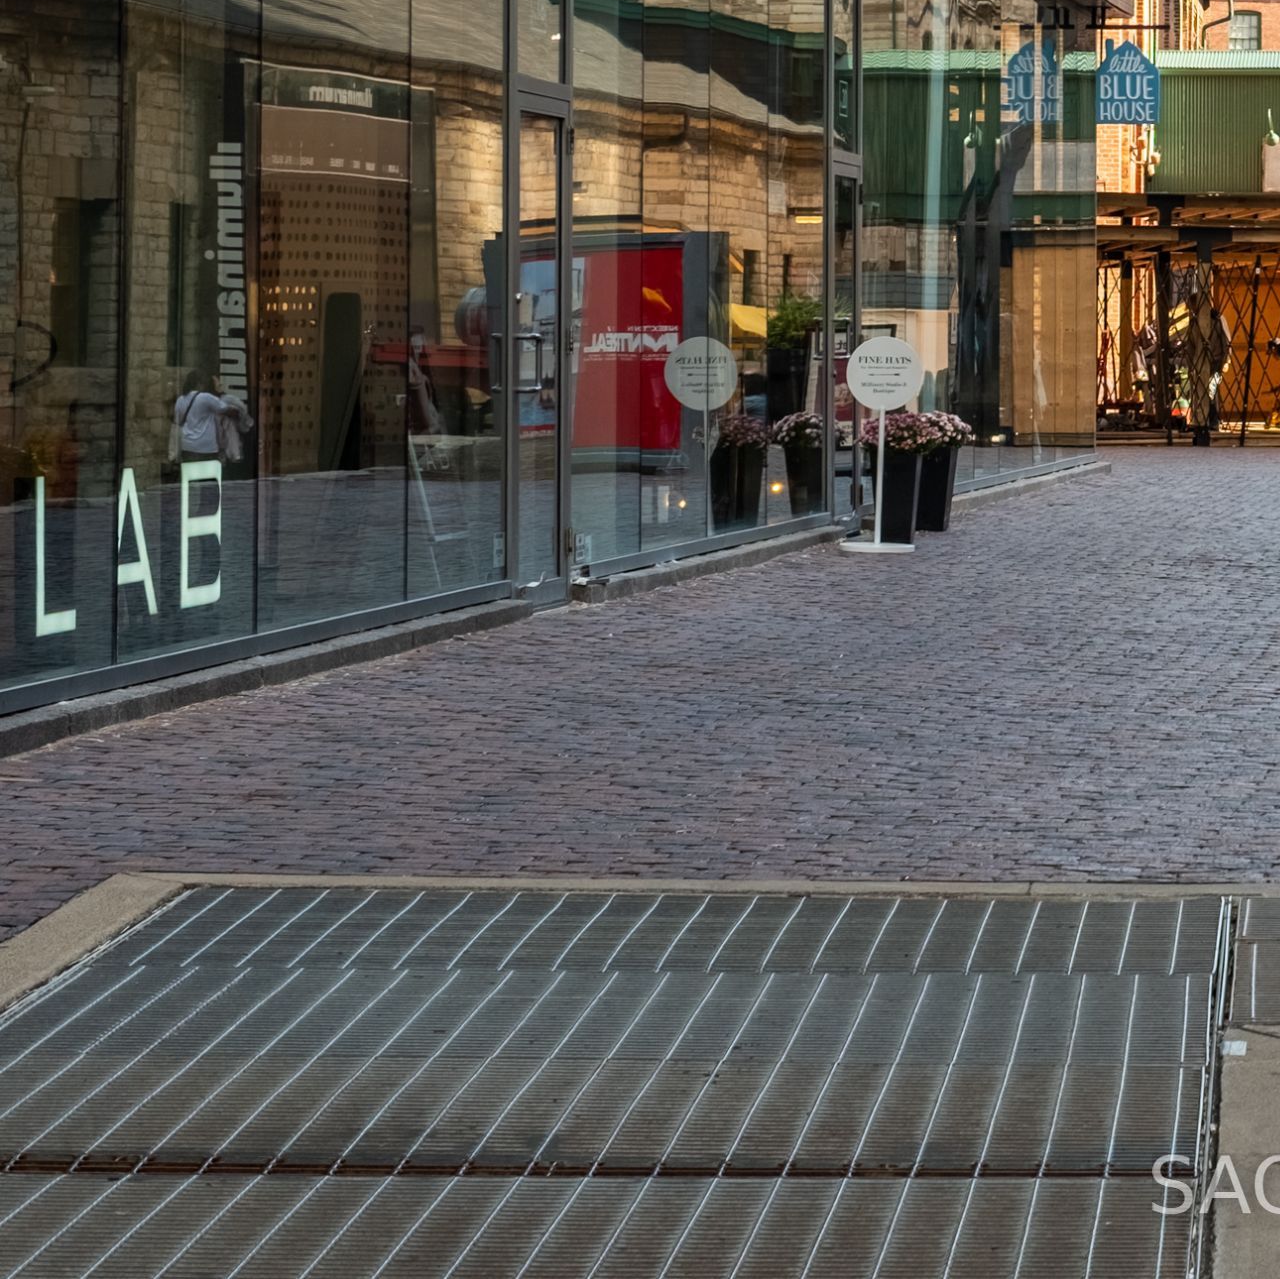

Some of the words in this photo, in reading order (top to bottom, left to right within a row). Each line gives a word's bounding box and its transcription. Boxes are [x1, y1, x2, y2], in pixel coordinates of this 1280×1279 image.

[1107, 51, 1148, 73] little
[1100, 75, 1155, 99] BLUE
[1101, 102, 1155, 121] HOUSE
[859, 356, 882, 364] FINE
[885, 356, 911, 364] HATS
[36, 460, 222, 637] LAB
